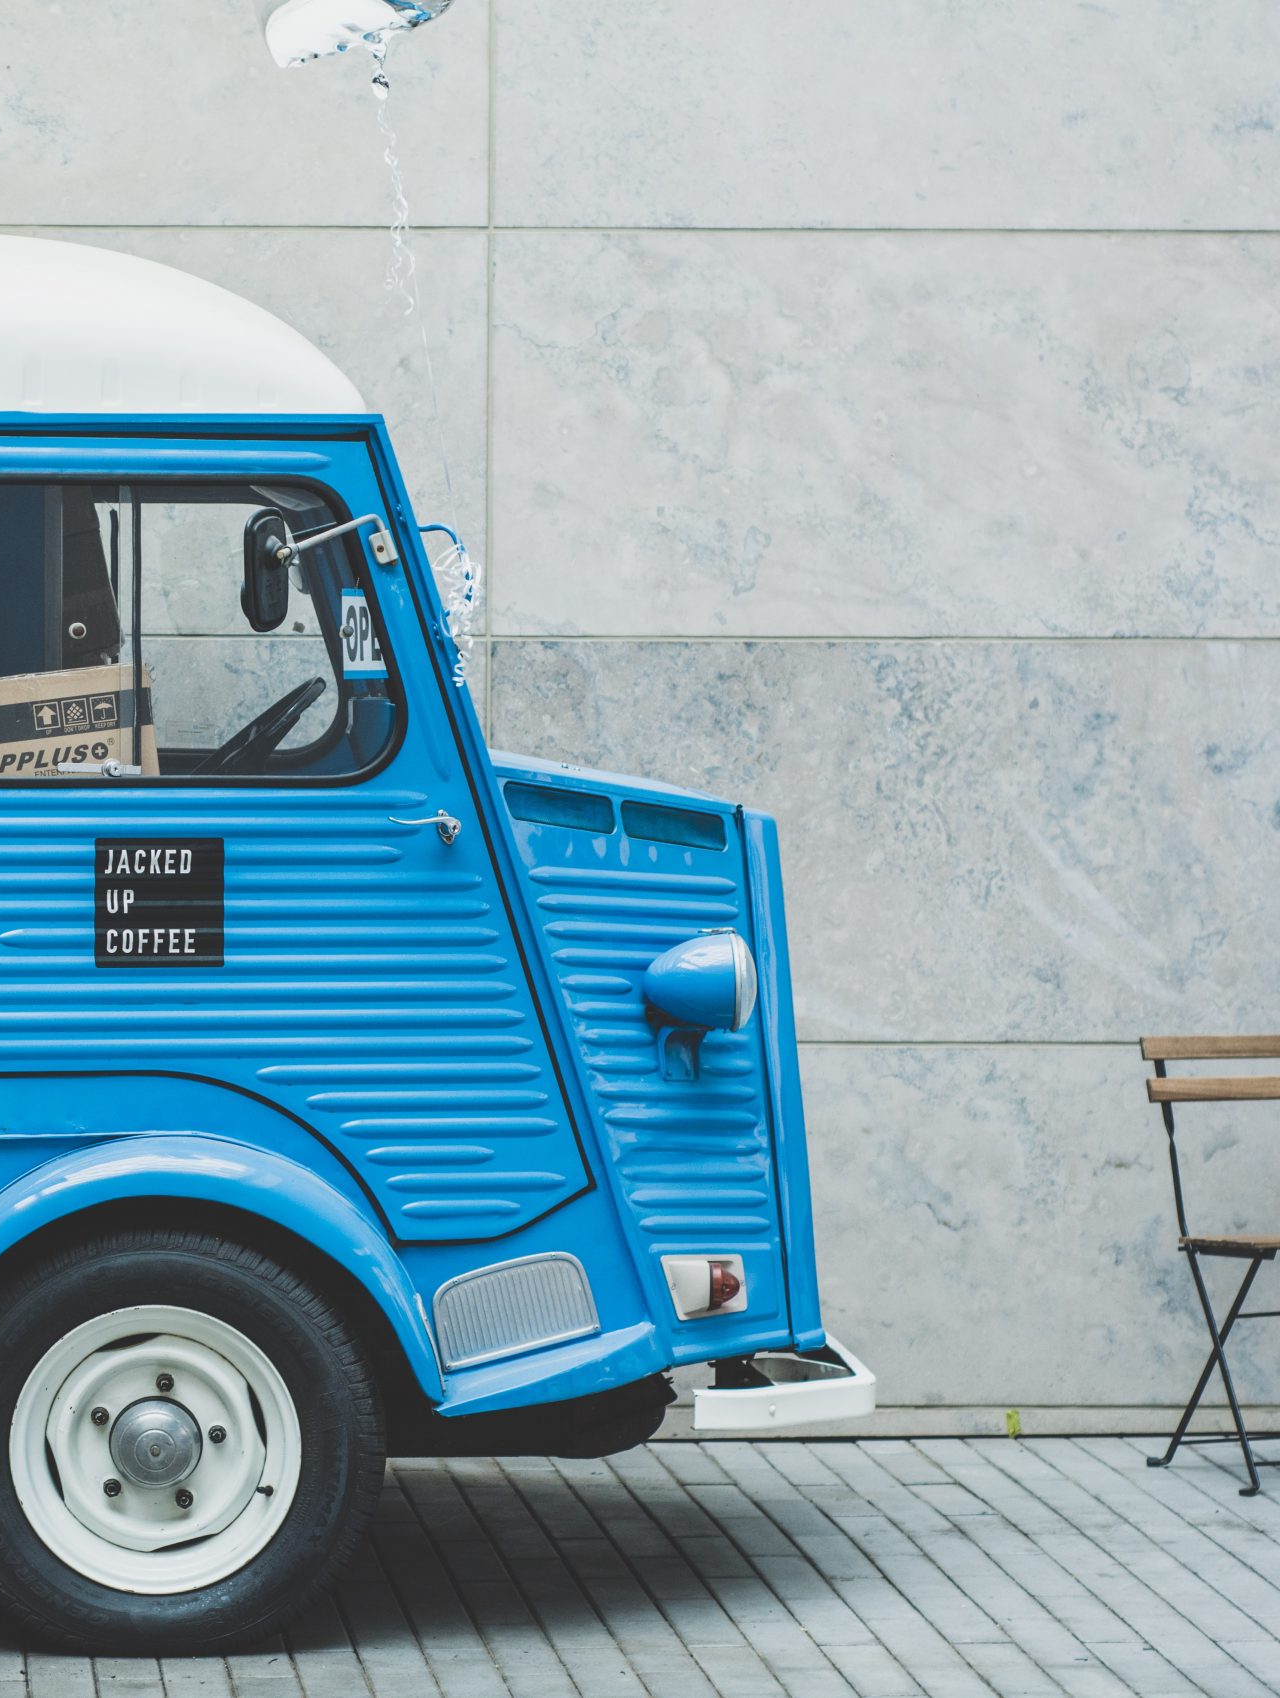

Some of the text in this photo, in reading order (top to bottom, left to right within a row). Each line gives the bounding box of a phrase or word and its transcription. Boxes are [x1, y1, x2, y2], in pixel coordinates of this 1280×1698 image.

[105, 849, 192, 874] JACKED
[106, 889, 135, 913] UP
[106, 929, 196, 953] COFFEE
